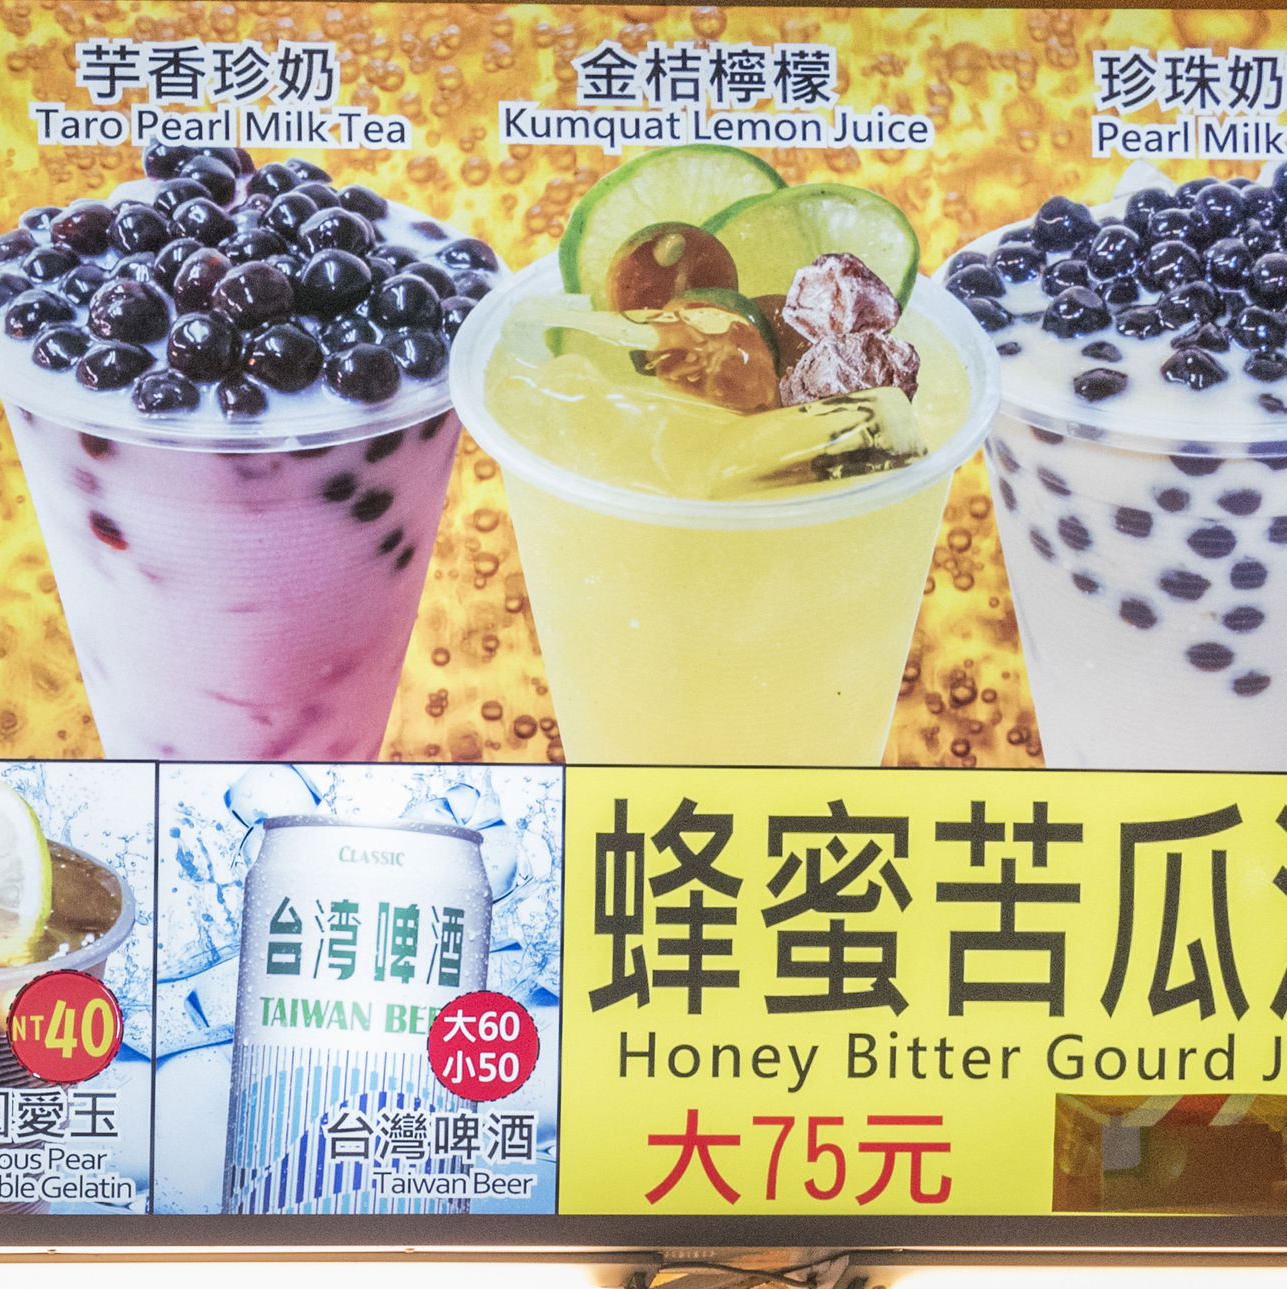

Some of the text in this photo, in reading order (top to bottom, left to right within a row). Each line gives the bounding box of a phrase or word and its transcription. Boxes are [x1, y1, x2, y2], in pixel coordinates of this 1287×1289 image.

[83, 44, 334, 102] 芋香珍奶
[580, 47, 832, 105] 金桔檸檬
[37, 110, 406, 145] Taro Pearl Milk Tea
[504, 108, 930, 149] Kumquat Lemon Juice
[588, 796, 1287, 1021] 蜂蜜苦瓜
[260, 997, 372, 1032] TAIWAN
[442, 1009, 520, 1043] 大60
[442, 1051, 520, 1084] 小50
[619, 1031, 1237, 1092] Honey Bitter Gourd
[327, 1112, 535, 1161] 台灣啤酒
[645, 1107, 953, 1206] 大75元
[374, 1171, 533, 1195] Taiwan Beer
